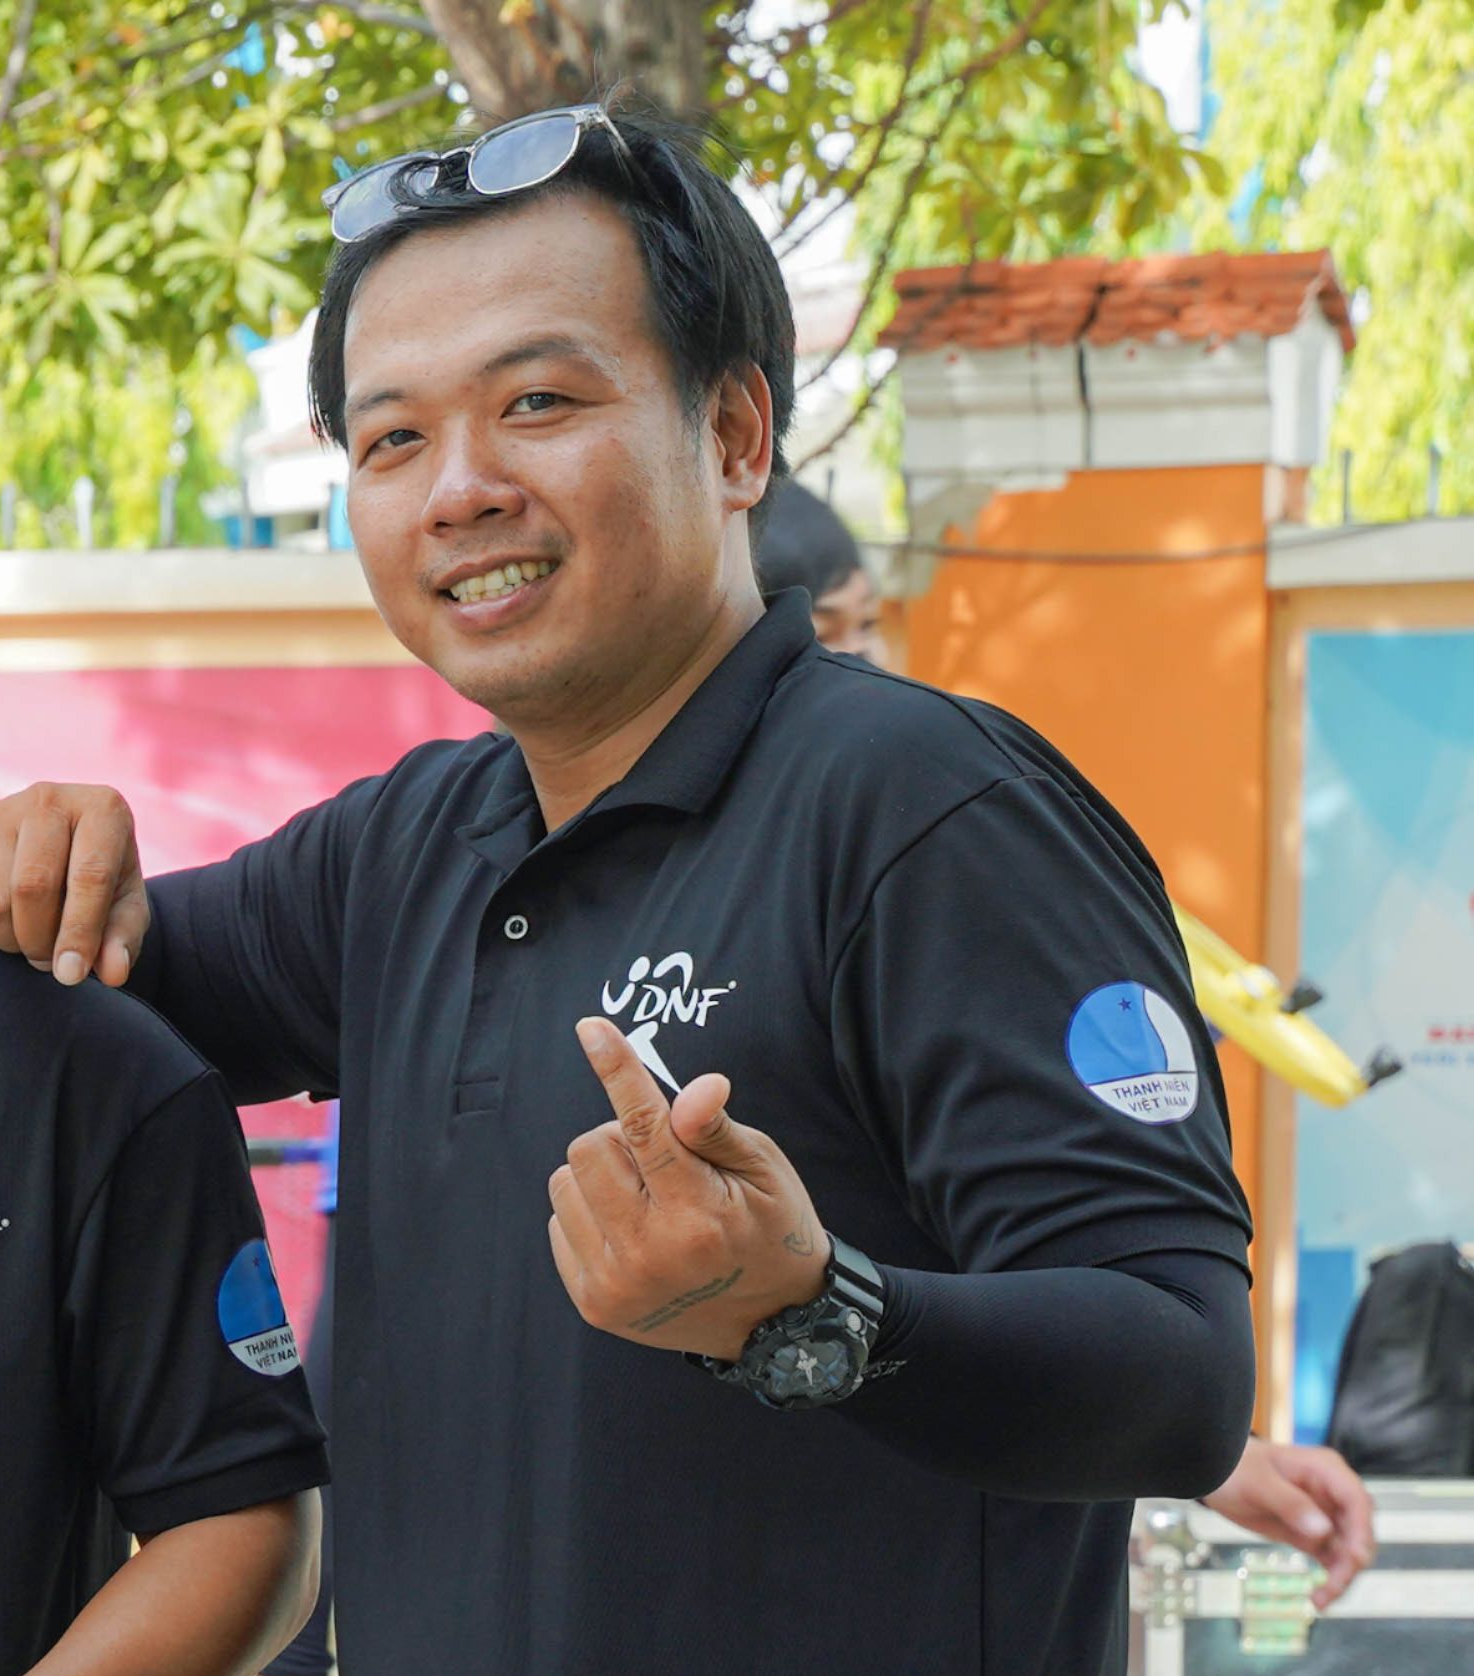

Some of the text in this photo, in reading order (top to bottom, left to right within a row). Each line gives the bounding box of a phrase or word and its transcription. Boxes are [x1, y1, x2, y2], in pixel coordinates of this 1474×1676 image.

[633, 984, 730, 1026] DNF
[1112, 1081, 1161, 1099] THANH
[1128, 1096, 1189, 1114] VIỆT NAM
